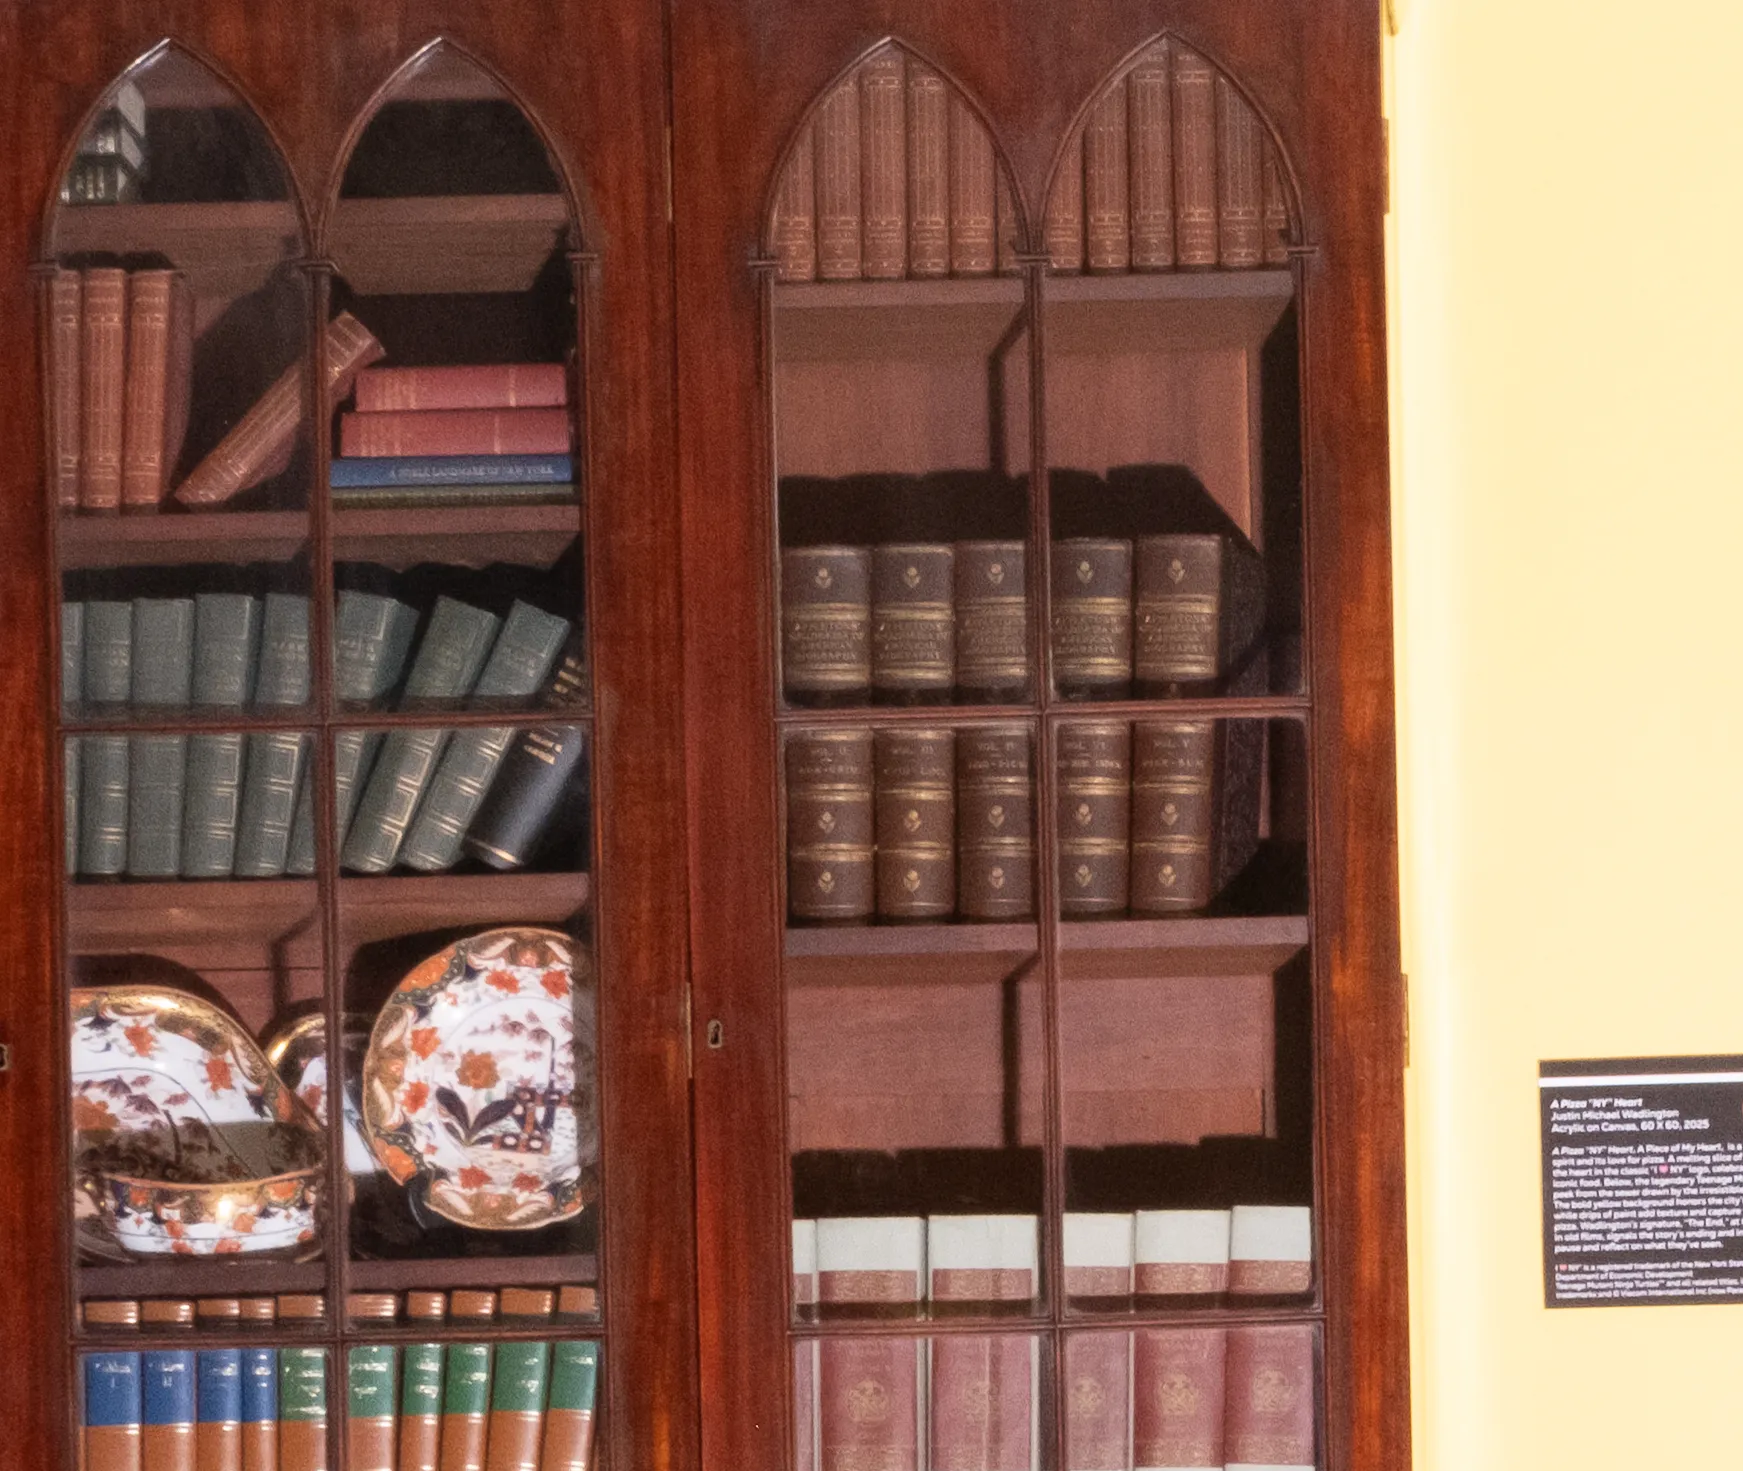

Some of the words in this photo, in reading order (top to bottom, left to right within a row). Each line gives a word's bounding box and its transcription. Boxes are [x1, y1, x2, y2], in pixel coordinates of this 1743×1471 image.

[1550, 1100, 1559, 1108] A
[1560, 1099, 1587, 1108] Pizza
[1614, 1097, 1643, 1107] Heart
[1552, 1111, 1581, 1120] Justin
[1582, 1110, 1620, 1120] Michael
[1552, 1123, 1585, 1134] Acrylic
[1586, 1124, 1600, 1132] on
[1640, 1121, 1655, 1130] 60
[1656, 1121, 1664, 1130] X
[1684, 1120, 1710, 1129] 2025
